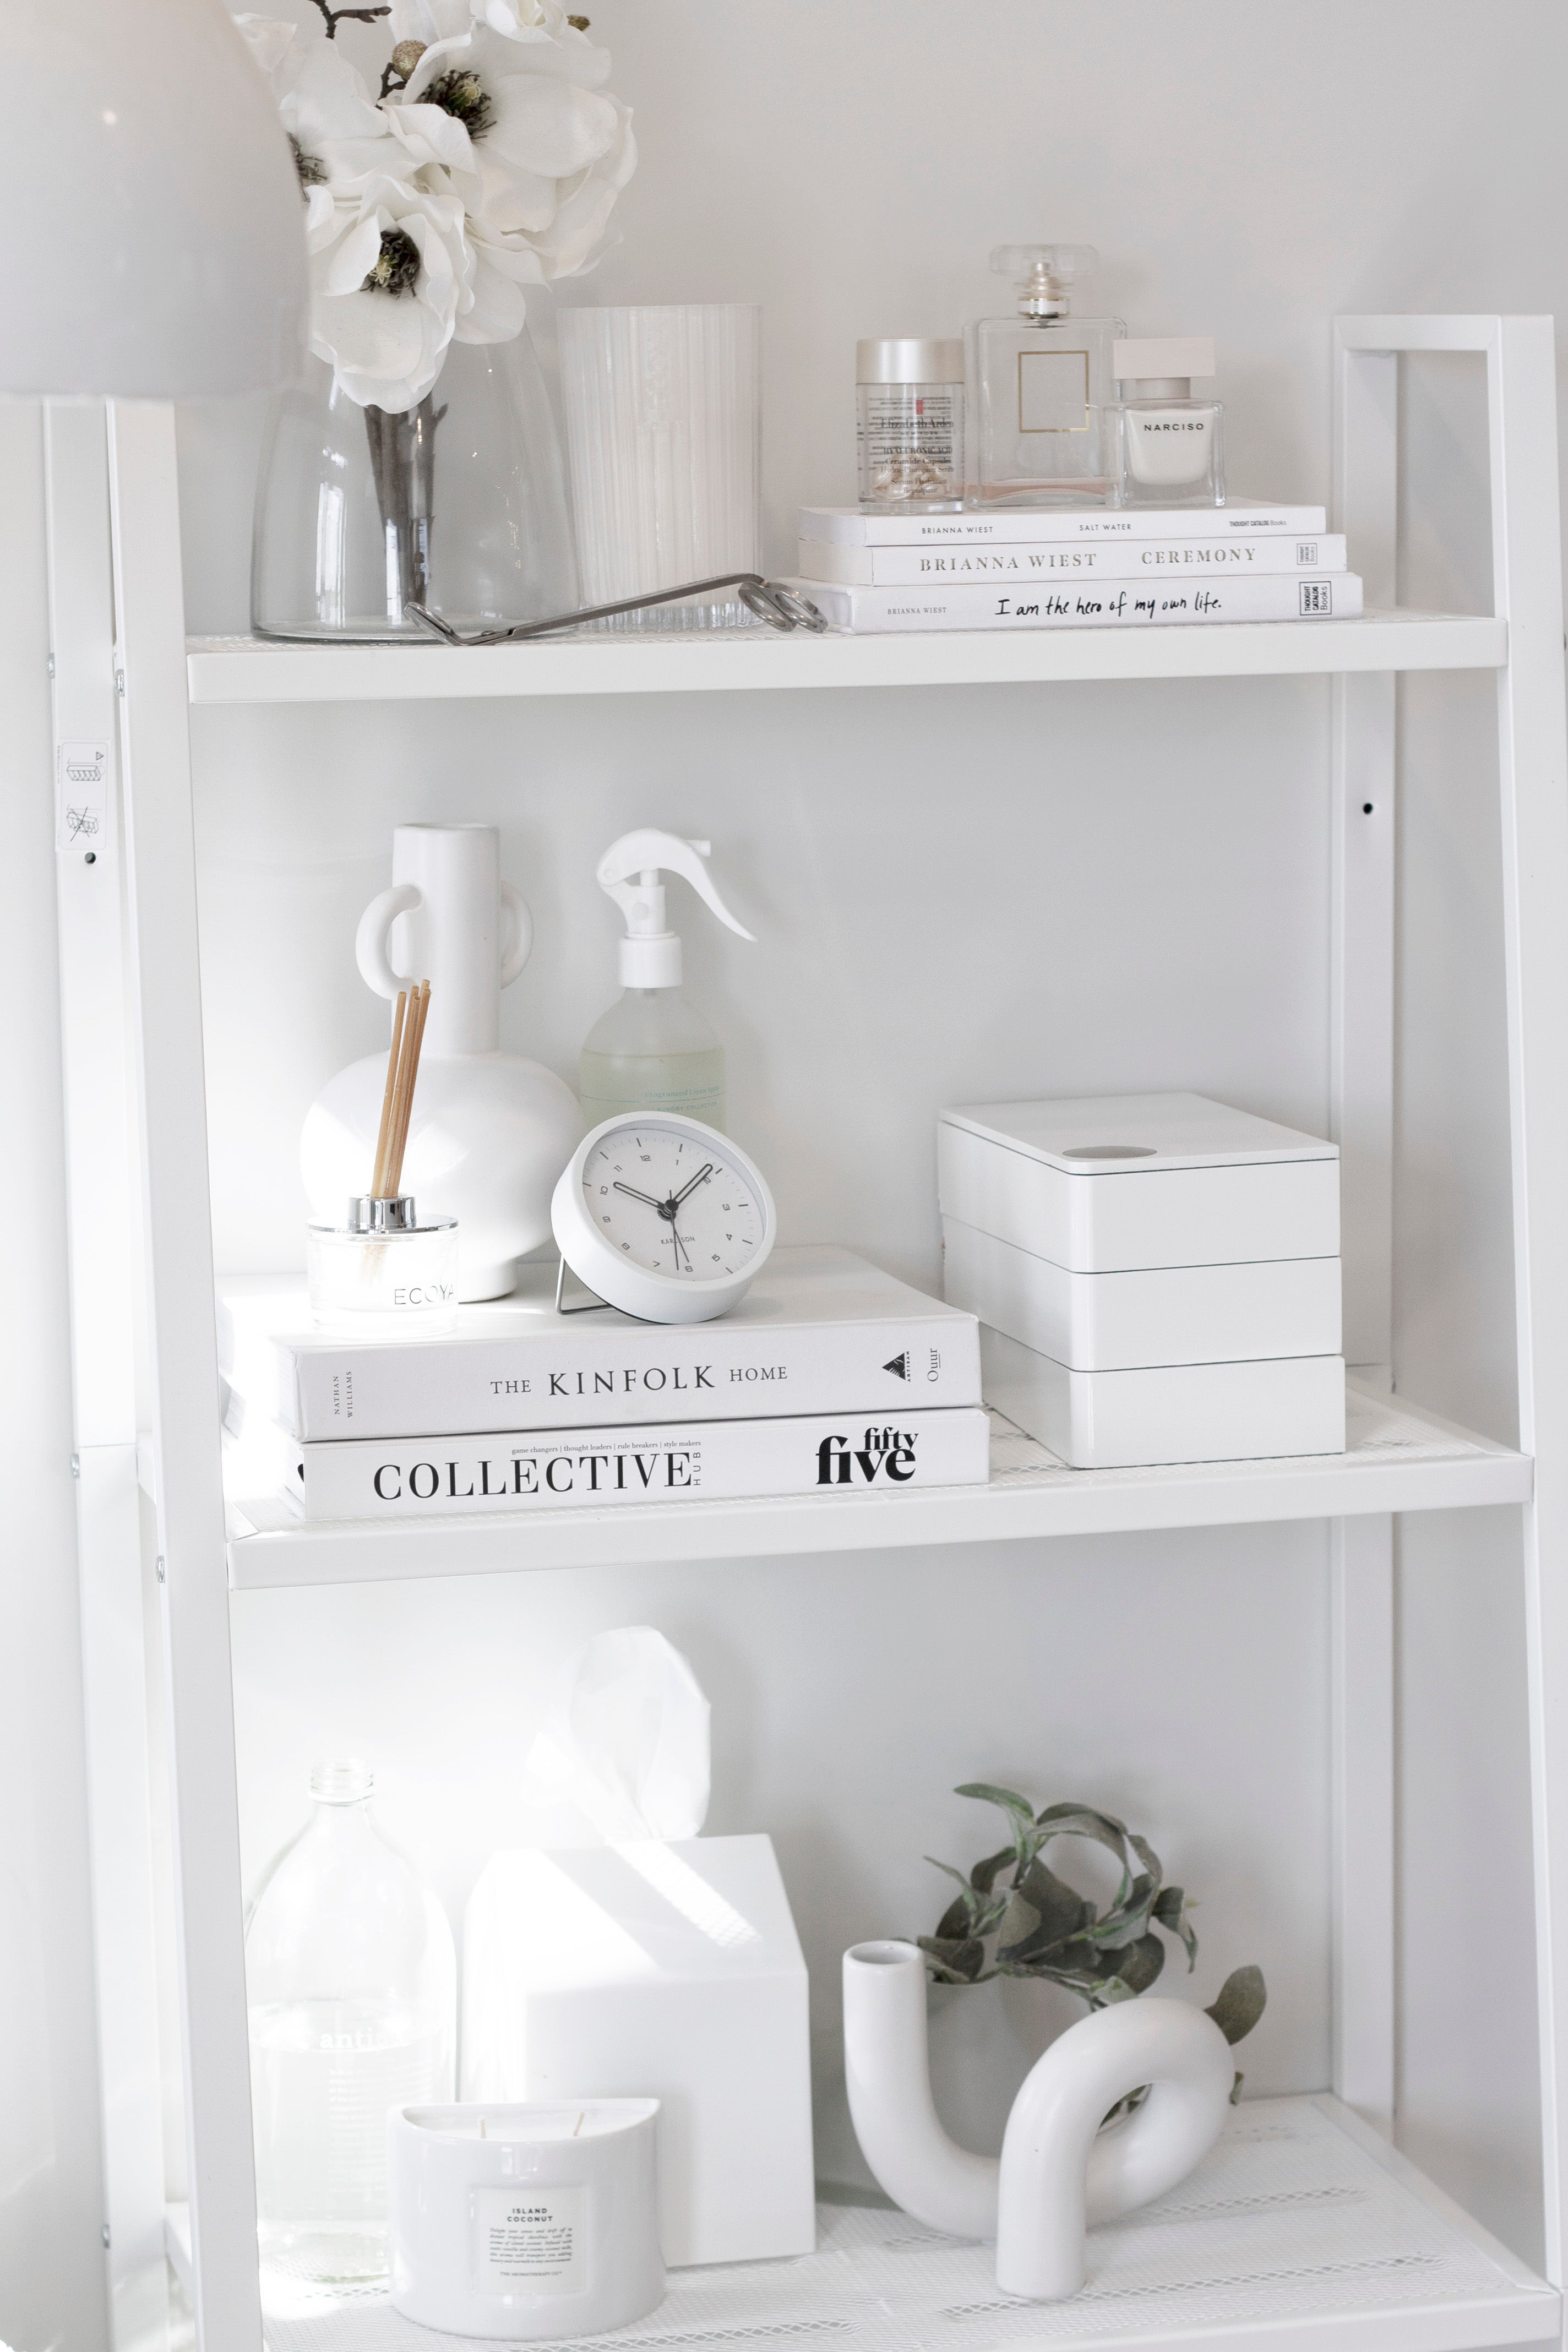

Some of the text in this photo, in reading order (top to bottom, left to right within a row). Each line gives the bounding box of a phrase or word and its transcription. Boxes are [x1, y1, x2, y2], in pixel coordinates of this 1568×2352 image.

[1144, 423, 1204, 431] NARCISO
[920, 553, 1097, 571] BRIANNA WIEST
[1141, 548, 1255, 564] CEREMONY
[994, 591, 1222, 619] I am the hero of my own life.
[1320, 586, 1328, 611] Books
[600, 1185, 608, 1196] 10
[621, 1242, 630, 1251] 8
[711, 1254, 721, 1262] 5
[394, 1284, 454, 1305] ECOYA
[927, 1348, 939, 1382] Ouur
[490, 1365, 788, 1396] THE KINFOLK HOME
[563, 1444, 589, 1453] thought
[663, 1440, 678, 1449] style
[864, 1427, 919, 1451] fifty
[693, 1452, 701, 1486] HUB
[815, 1435, 916, 1485] five
[373, 1452, 692, 1500] COLLECTIVE
